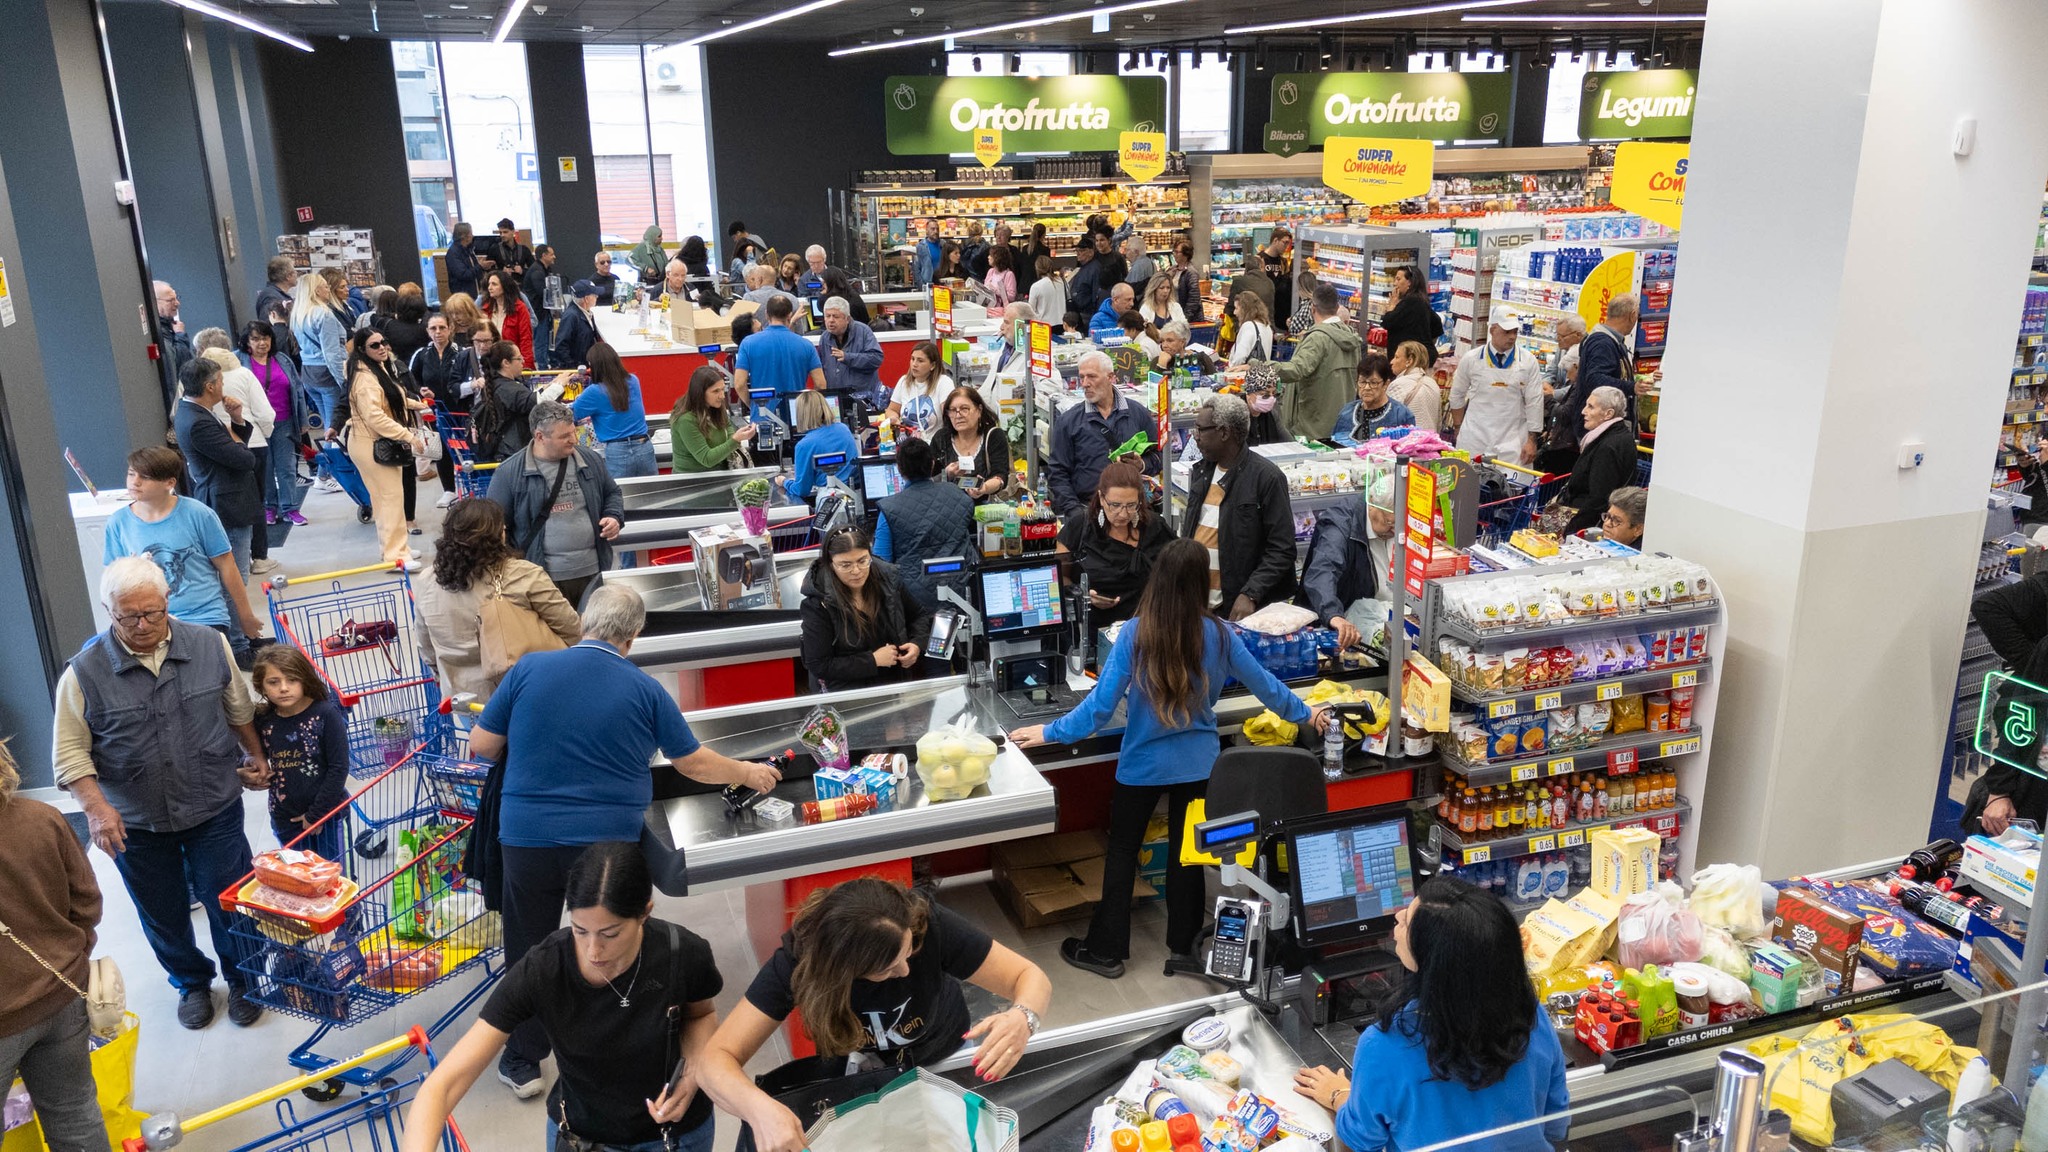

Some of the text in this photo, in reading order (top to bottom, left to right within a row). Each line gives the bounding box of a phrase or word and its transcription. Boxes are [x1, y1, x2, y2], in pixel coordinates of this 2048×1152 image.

[1324, 92, 1460, 124] Ortofrutta
[1599, 86, 1694, 126] Legumi
[950, 98, 1109, 131] Ortofrutta
[1270, 130, 1304, 141] Bilancia
[1131, 141, 1151, 152] SUPER
[1124, 149, 1159, 162] Conveniente
[1357, 148, 1393, 162] SUPER
[522, 155, 536, 179] P
[1343, 158, 1407, 176] Conveniente
[1486, 233, 1534, 248] NEOS
[1031, 524, 1052, 533] Coca-Cola
[1682, 675, 1695, 685] 2.19
[1607, 688, 1620, 698] 1.15
[1545, 697, 1559, 707] 0.79
[1500, 704, 1513, 715] 0.79
[1671, 742, 1698, 755] 1.69 1.69
[1620, 752, 1633, 762] 0.69
[1558, 762, 1572, 772] 1.00
[1522, 769, 1536, 779] 1.39
[1662, 818, 1674, 828] 0.69
[1539, 839, 1552, 850] 0.65
[1568, 834, 1581, 844] 0.69
[1474, 851, 1487, 862] 0.59
[1985, 860, 1995, 868] THE
[1996, 864, 2019, 882] PROTEIN
[1797, 928, 1815, 938] COCO
[1913, 977, 1942, 991] CLIENTE
[1822, 988, 1900, 1012] CLIENTE SUCCESSIVO
[1189, 1020, 1225, 1043] PHILADELPHIA
[1667, 1026, 1734, 1047] CASSA CHIUSA
